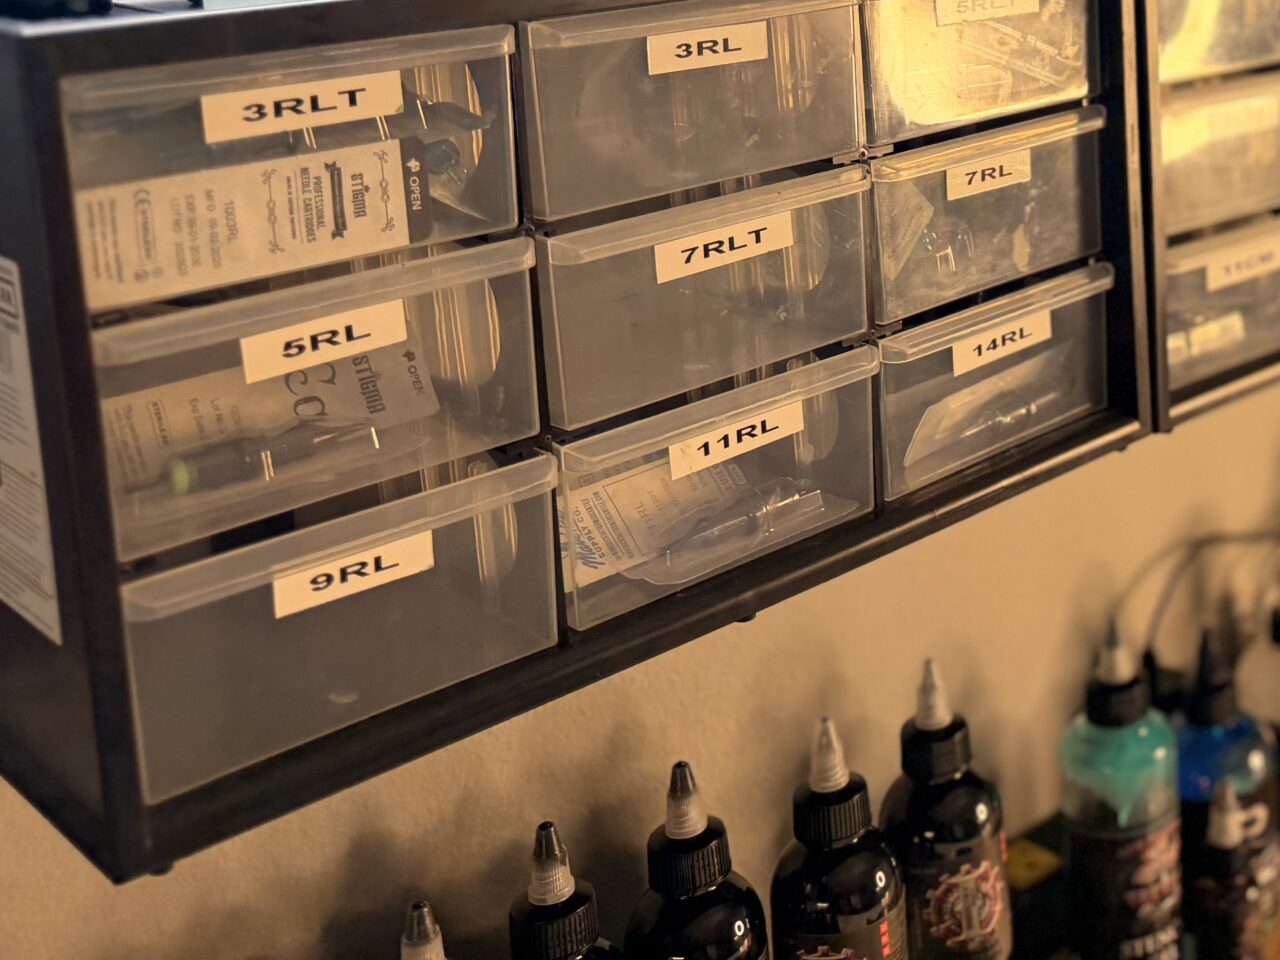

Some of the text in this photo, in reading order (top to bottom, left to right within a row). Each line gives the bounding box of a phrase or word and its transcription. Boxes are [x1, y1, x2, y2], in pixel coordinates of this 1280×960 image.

[675, 37, 742, 59] 3RL
[241, 87, 367, 123] 3RLT
[965, 164, 1013, 186] 7RL
[300, 167, 317, 244] NEEDLE CARTRIDGES
[313, 176, 326, 230] PROFESSIONAL
[350, 173, 367, 218] STIGMA
[409, 176, 422, 211] OPEN
[680, 227, 769, 265] 7RLT
[281, 323, 372, 359] 5RL
[972, 326, 1033, 358] 14RL
[352, 354, 387, 415] STIGMA
[697, 418, 780, 458] 11RL
[573, 506, 585, 524] CO.
[581, 524, 606, 559] SUPPLY
[309, 555, 400, 592] 9RL
